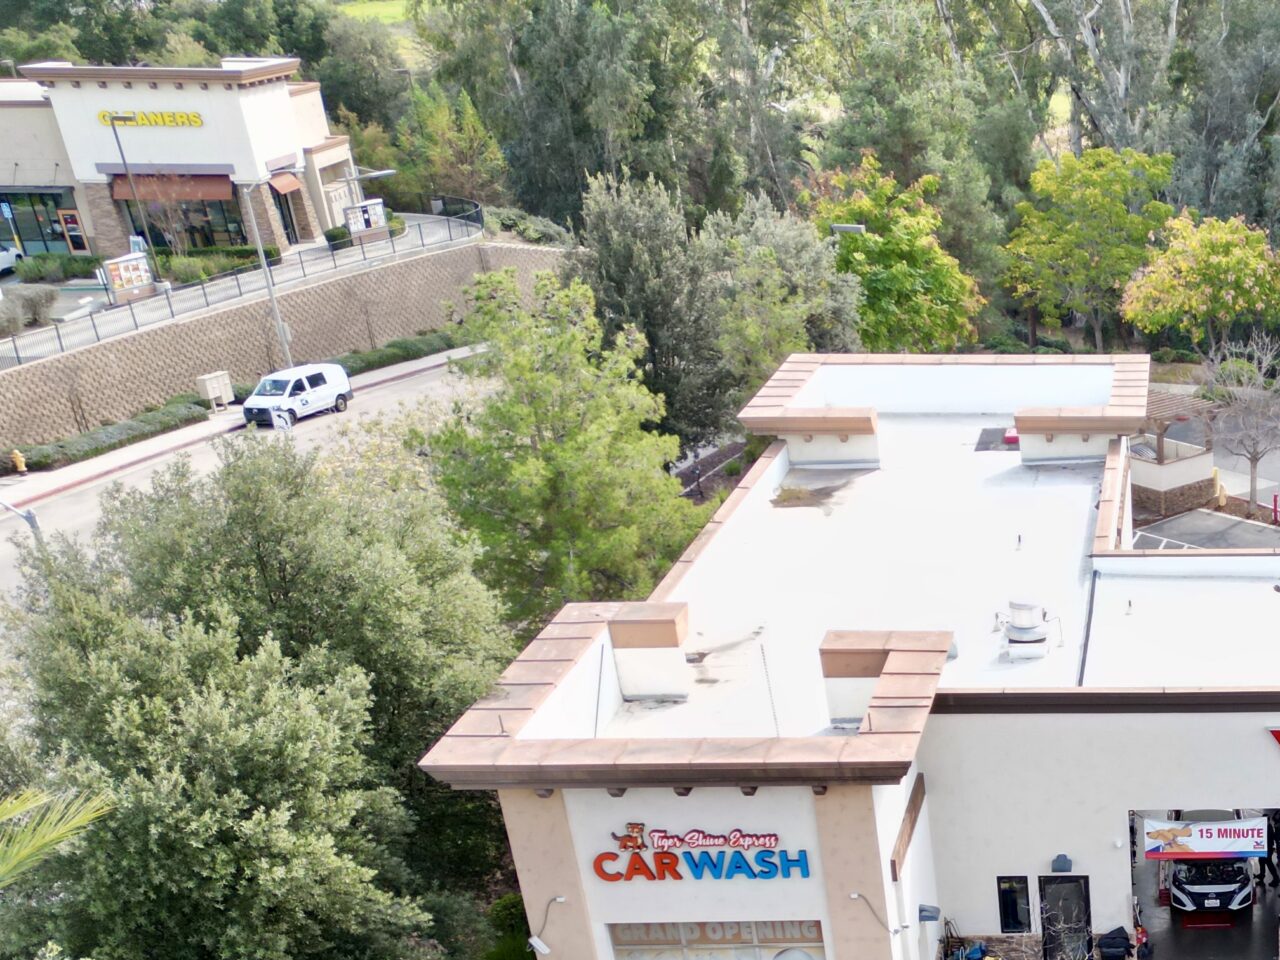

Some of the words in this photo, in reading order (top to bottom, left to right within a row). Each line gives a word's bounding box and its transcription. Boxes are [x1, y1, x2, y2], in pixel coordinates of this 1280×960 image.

[649, 829, 683, 851] Tiger
[683, 829, 727, 848] Shine
[728, 828, 779, 850] Express
[1198, 828, 1213, 839] 15
[1217, 828, 1264, 839] MINUTE
[618, 922, 700, 942] GRAND
[704, 920, 818, 940] OPENING
